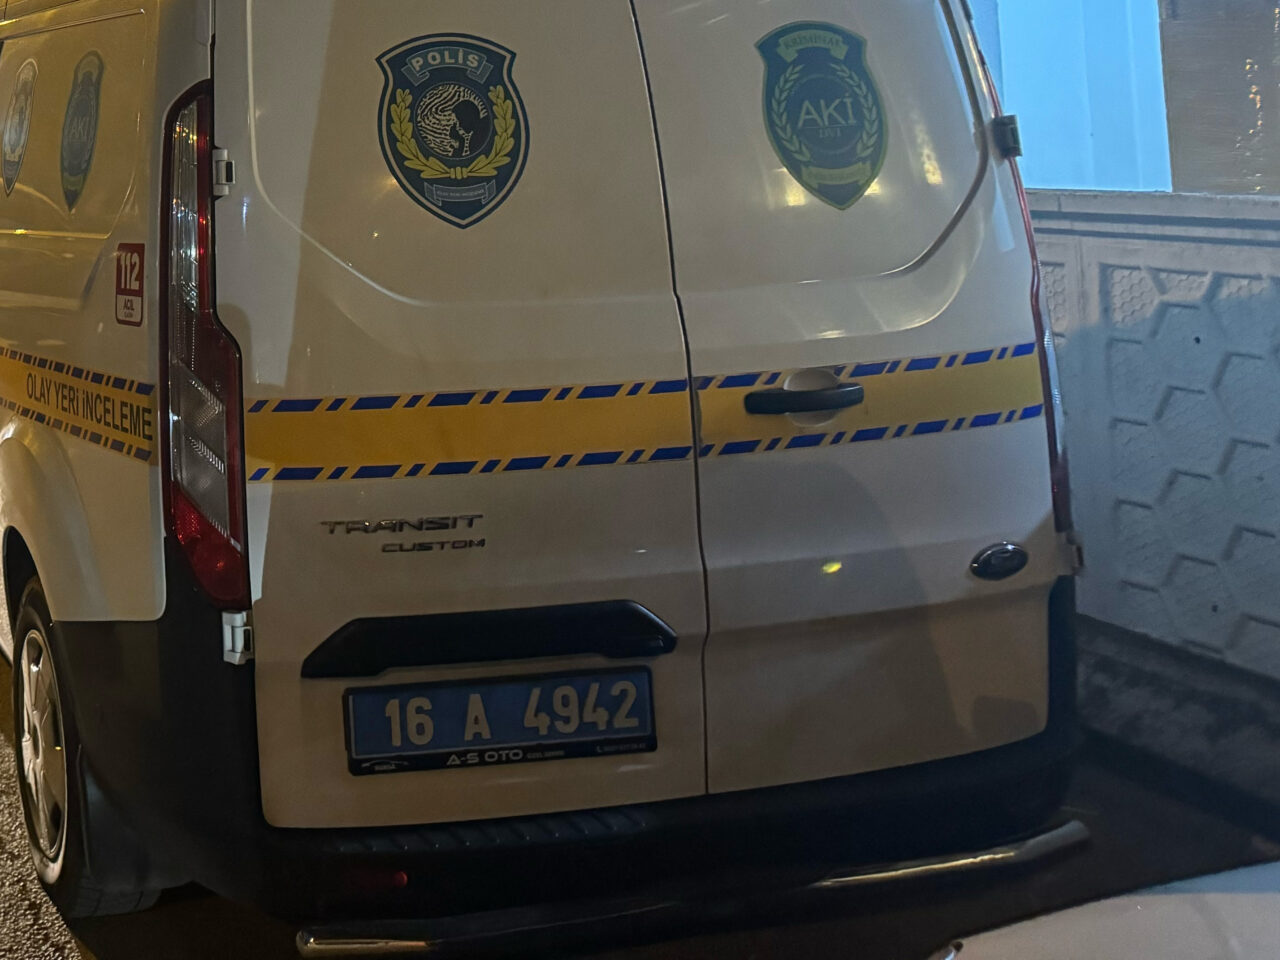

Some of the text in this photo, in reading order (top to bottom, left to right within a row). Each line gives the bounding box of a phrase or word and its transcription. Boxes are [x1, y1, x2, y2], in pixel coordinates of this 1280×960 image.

[120, 252, 140, 290] 112
[26, 373, 55, 406] OLAY
[320, 514, 484, 535] TRANSIT
[381, 538, 486, 553] CUSTOM
[384, 680, 640, 748] 16 A 4942
[484, 748, 524, 763] OTO
